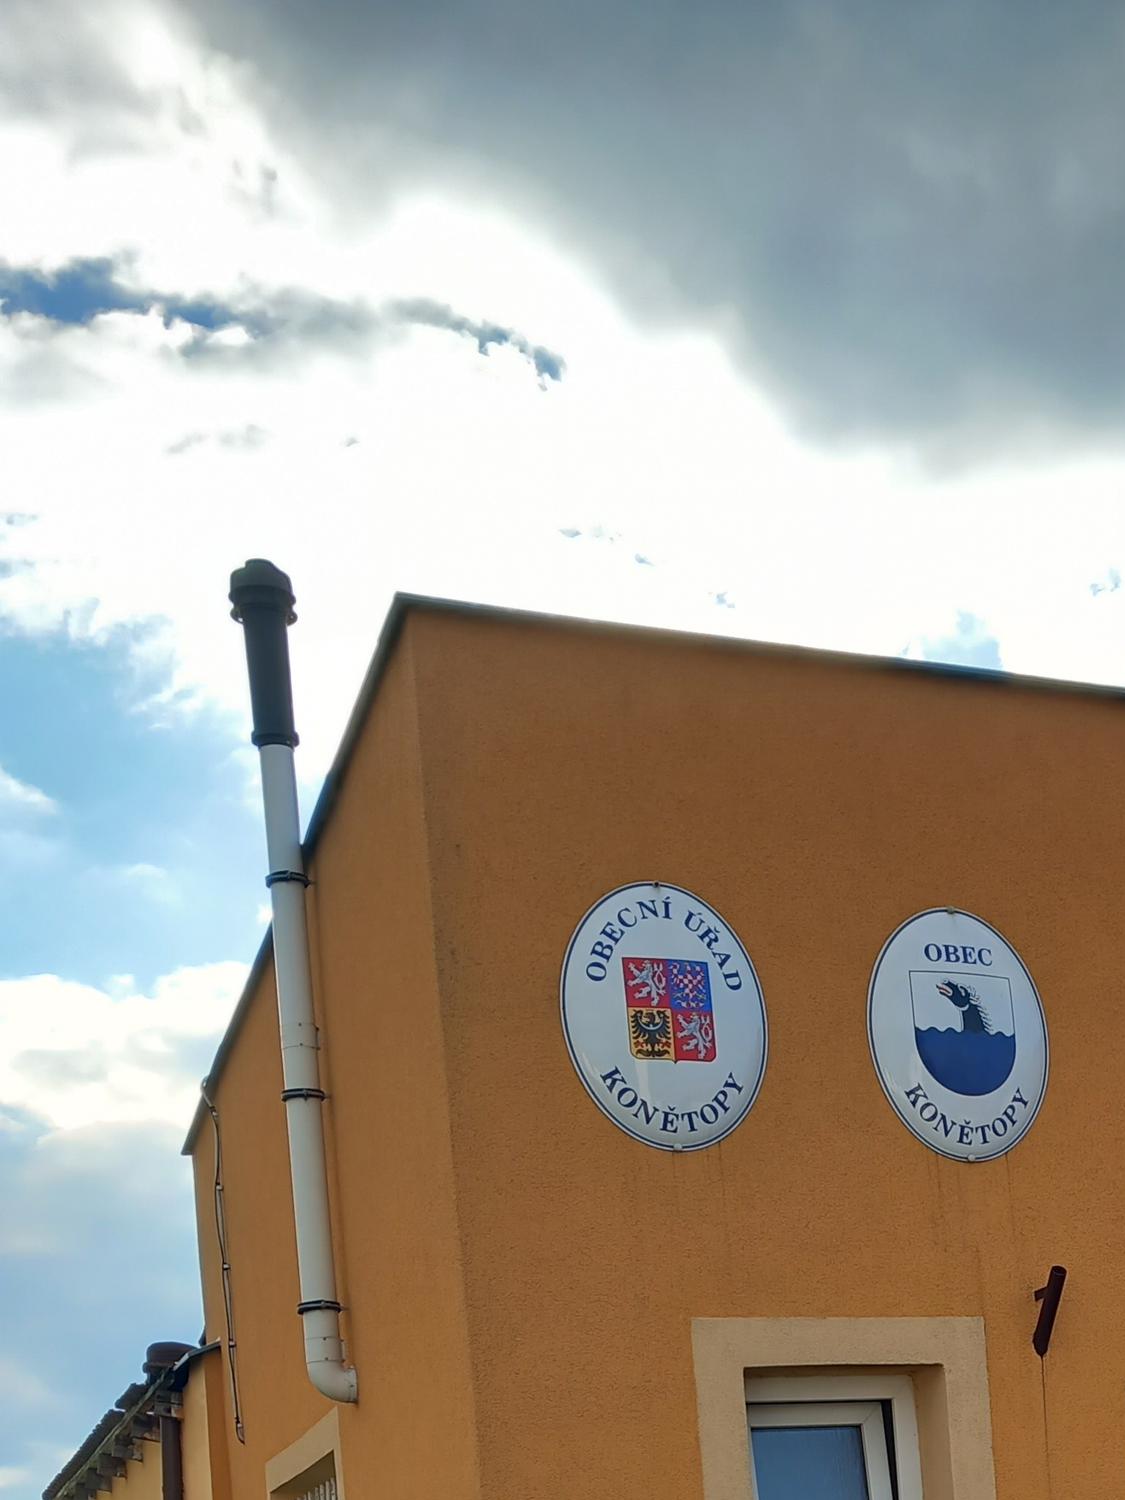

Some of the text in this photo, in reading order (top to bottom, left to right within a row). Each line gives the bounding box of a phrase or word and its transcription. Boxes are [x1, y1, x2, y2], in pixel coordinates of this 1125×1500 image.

[585, 896, 743, 991] OBECNÍ ÚŘAD
[924, 943, 993, 966] OBEC
[601, 1066, 744, 1134] KONĚTOPY
[904, 1082, 1029, 1146] KONĚTOPY
